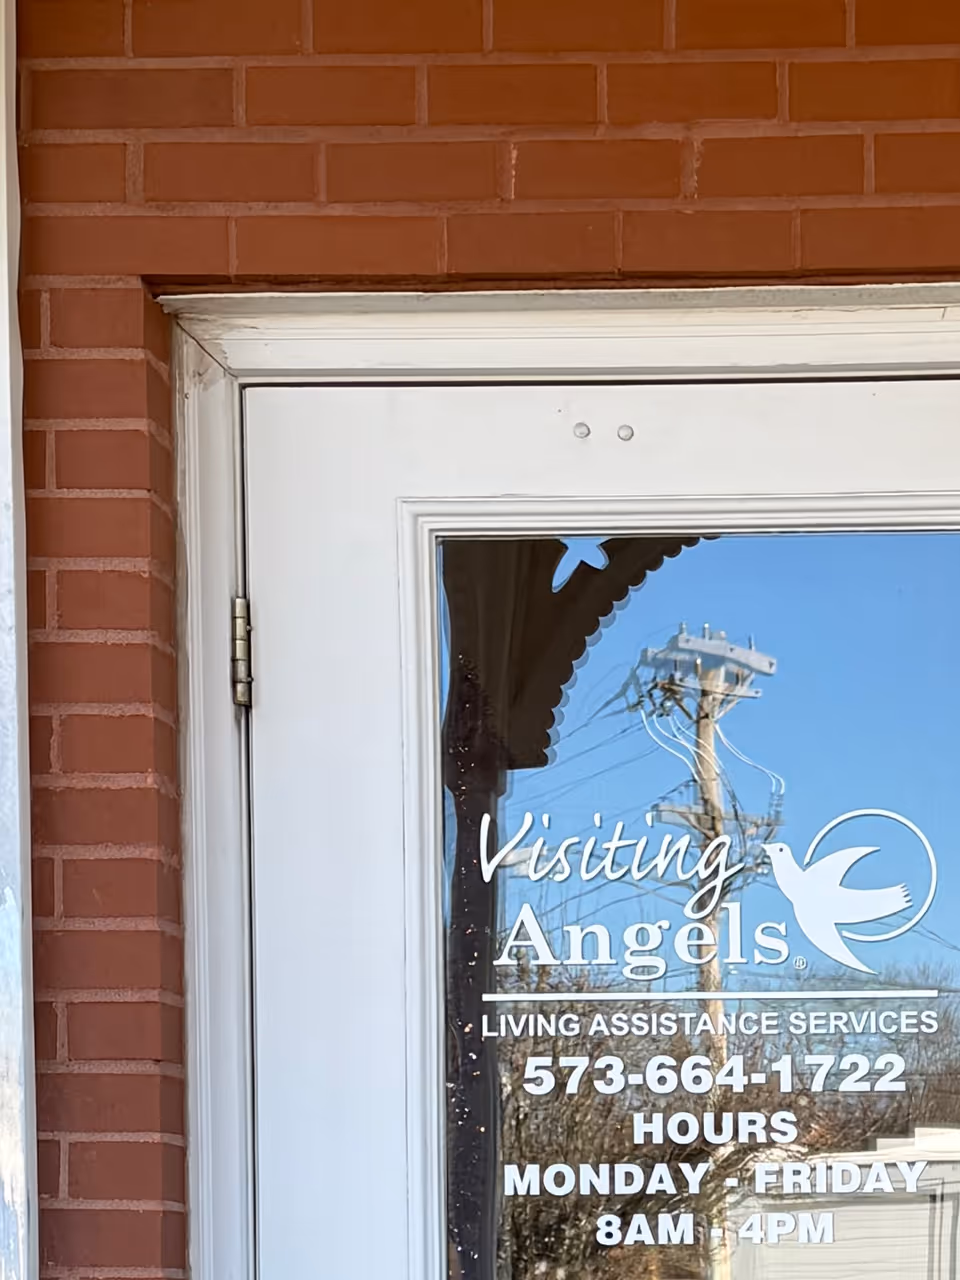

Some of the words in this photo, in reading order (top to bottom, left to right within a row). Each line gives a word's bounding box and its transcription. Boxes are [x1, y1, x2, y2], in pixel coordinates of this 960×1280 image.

[479, 811, 745, 920] Visiting
[481, 1013, 581, 1038] LIVING
[589, 1011, 780, 1036] ASSISTANCE
[789, 1010, 939, 1035] SERVICES
[522, 1053, 907, 1096] 573-664-1722
[632, 1110, 799, 1145] HOURS
[503, 1162, 712, 1197] MONDAY
[754, 1160, 930, 1194] FRIDAY
[595, 1212, 695, 1246] 8AM
[737, 1212, 834, 1245] 4PM
